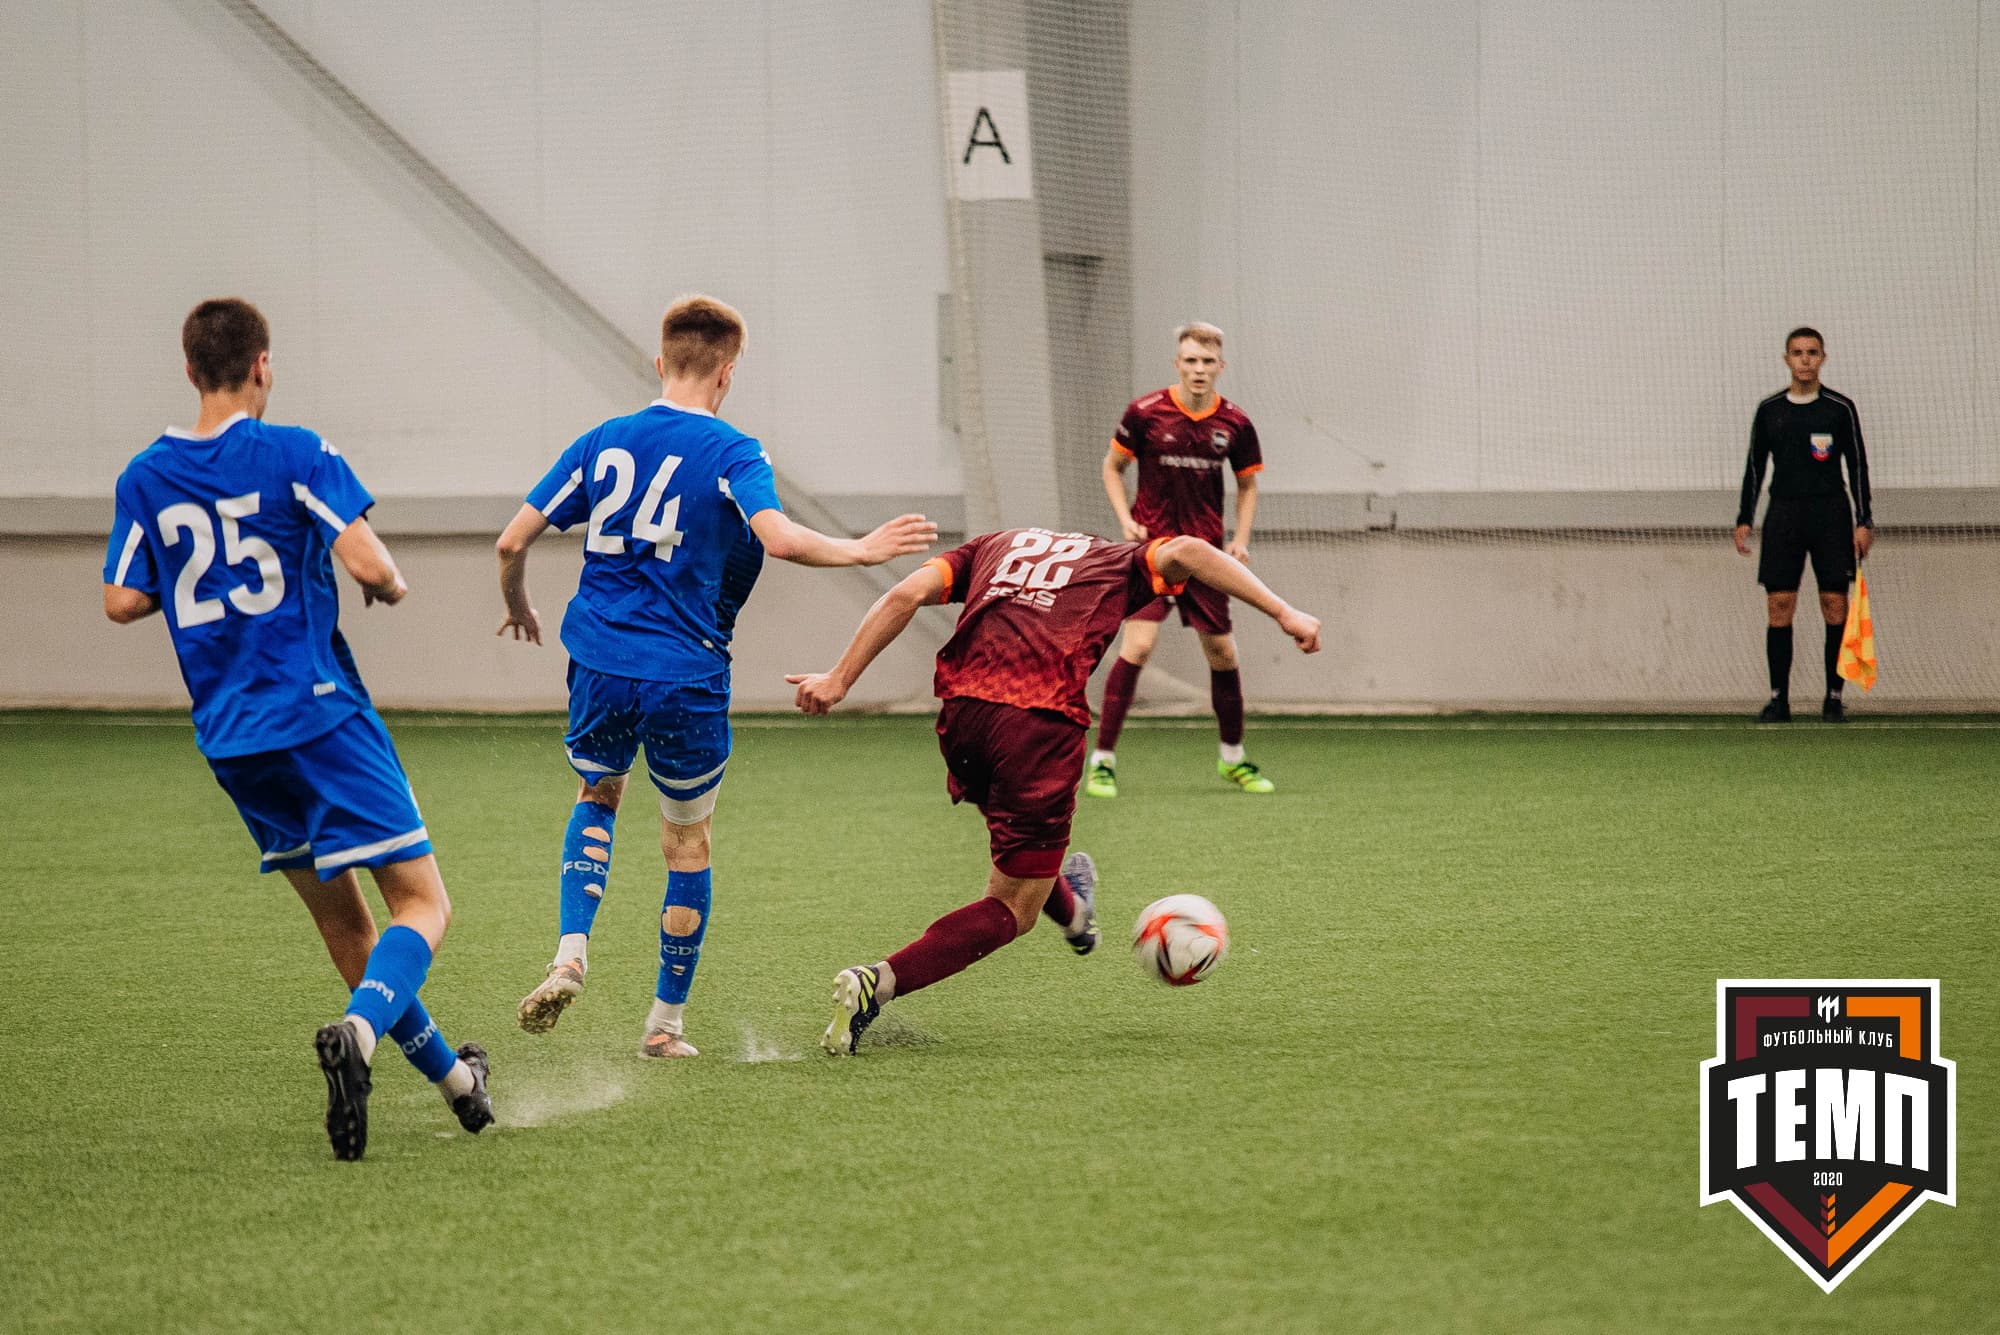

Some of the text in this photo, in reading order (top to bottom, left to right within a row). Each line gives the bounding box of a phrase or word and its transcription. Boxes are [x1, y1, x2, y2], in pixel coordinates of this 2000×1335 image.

[587, 447, 684, 562] 24
[157, 491, 285, 628] 25
[989, 532, 1091, 590] 22
[563, 860, 609, 879] FCD
